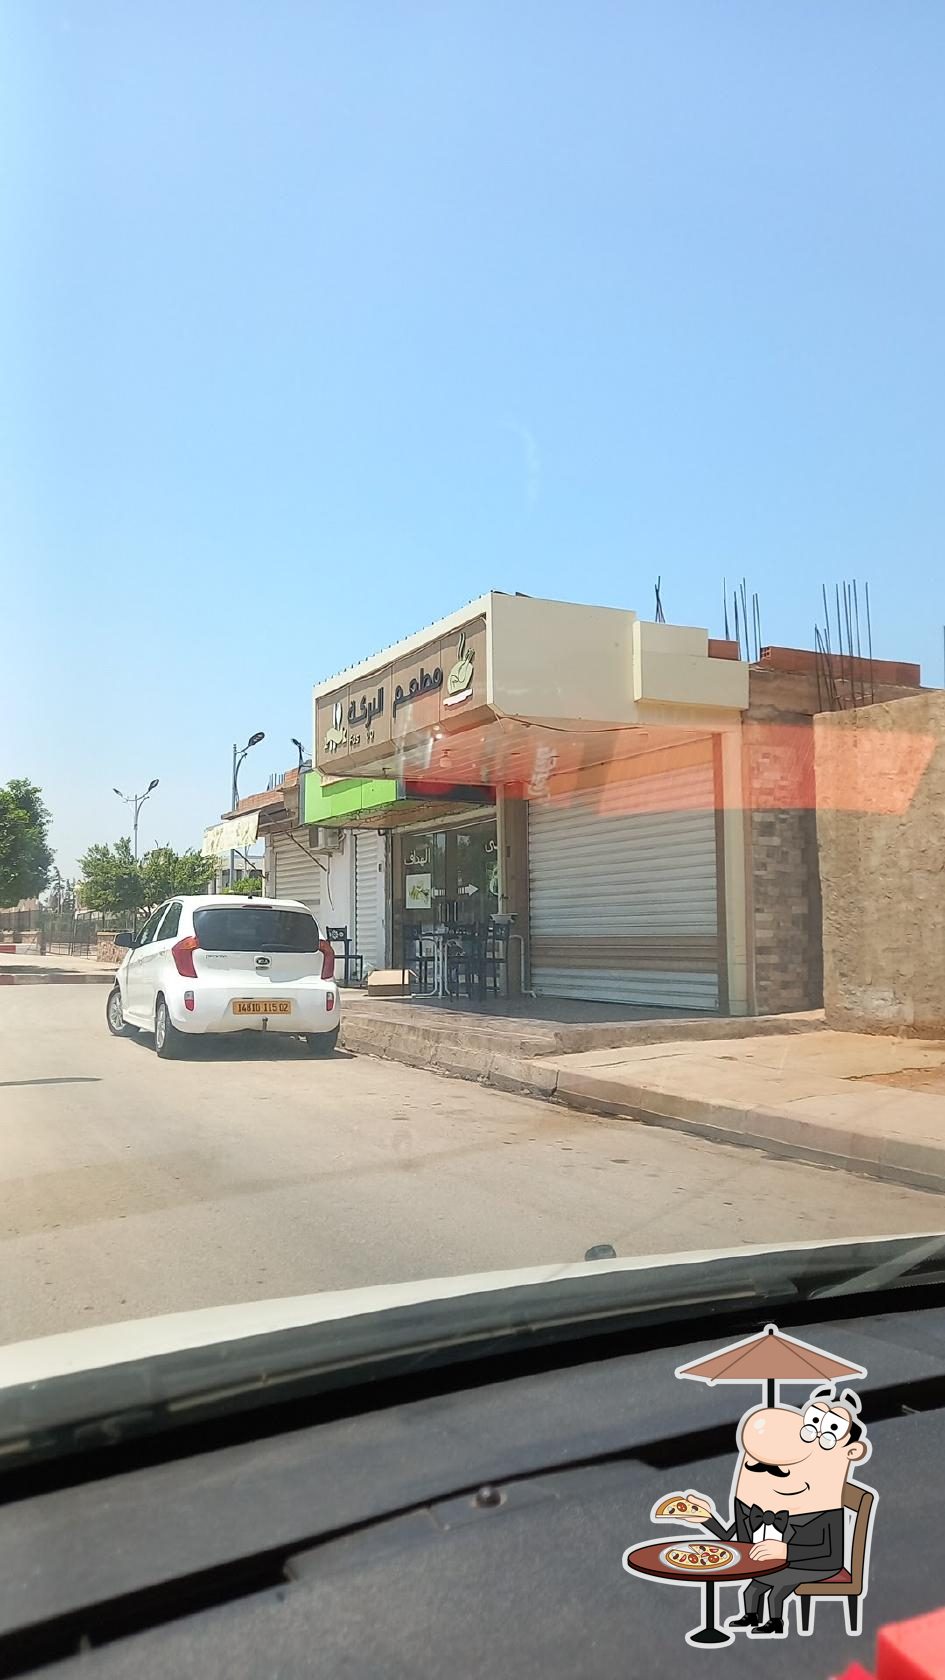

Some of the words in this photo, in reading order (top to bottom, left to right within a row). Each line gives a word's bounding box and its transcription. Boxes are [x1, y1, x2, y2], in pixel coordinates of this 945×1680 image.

[348, 686, 384, 729] البركة
[392, 667, 443, 718] مطعم
[263, 1003, 278, 1012] 115
